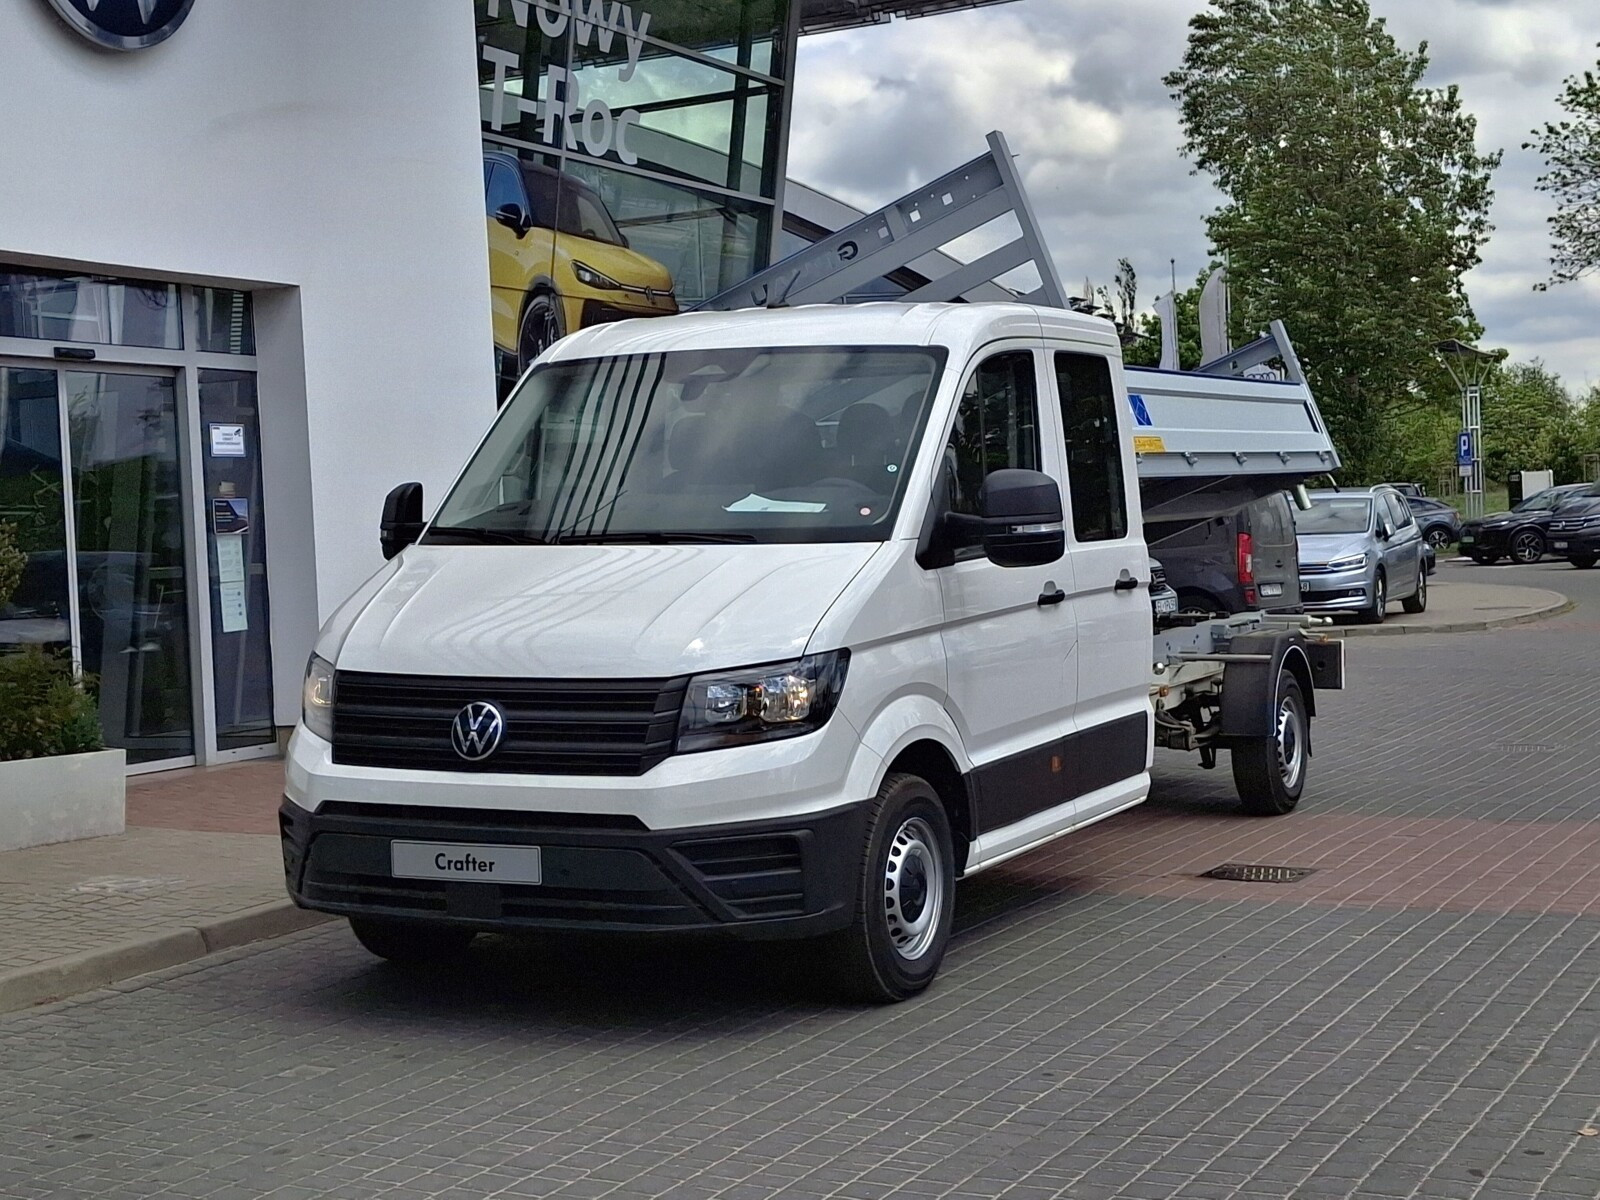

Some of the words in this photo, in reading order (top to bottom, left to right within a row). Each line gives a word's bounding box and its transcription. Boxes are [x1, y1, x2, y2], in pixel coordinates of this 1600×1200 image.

[486, 0, 651, 82] owy
[482, 45, 641, 165] T-Roc
[1460, 435, 1469, 457] P
[454, 703, 501, 758] VW
[434, 853, 496, 873] Crafter
